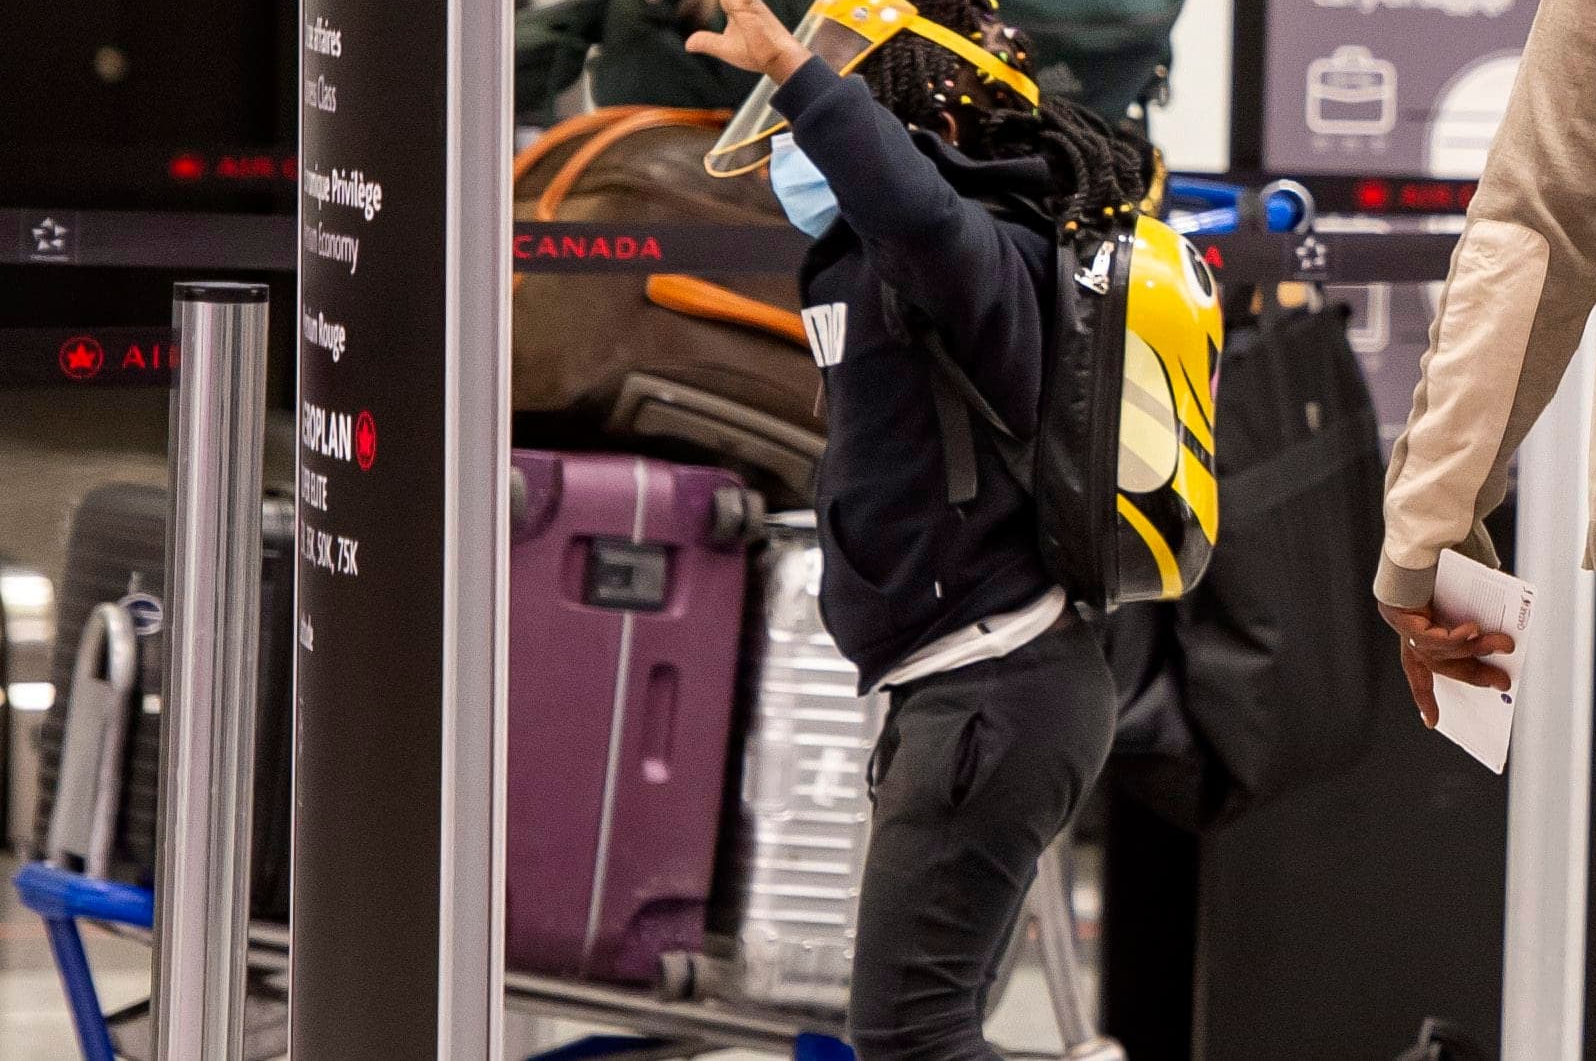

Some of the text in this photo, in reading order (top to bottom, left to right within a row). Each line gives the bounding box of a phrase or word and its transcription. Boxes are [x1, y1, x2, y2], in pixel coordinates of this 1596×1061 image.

[331, 168, 383, 222] Privilège
[513, 235, 662, 261] CANADA
[318, 311, 346, 363] Rouge
[337, 537, 359, 577] 75K
